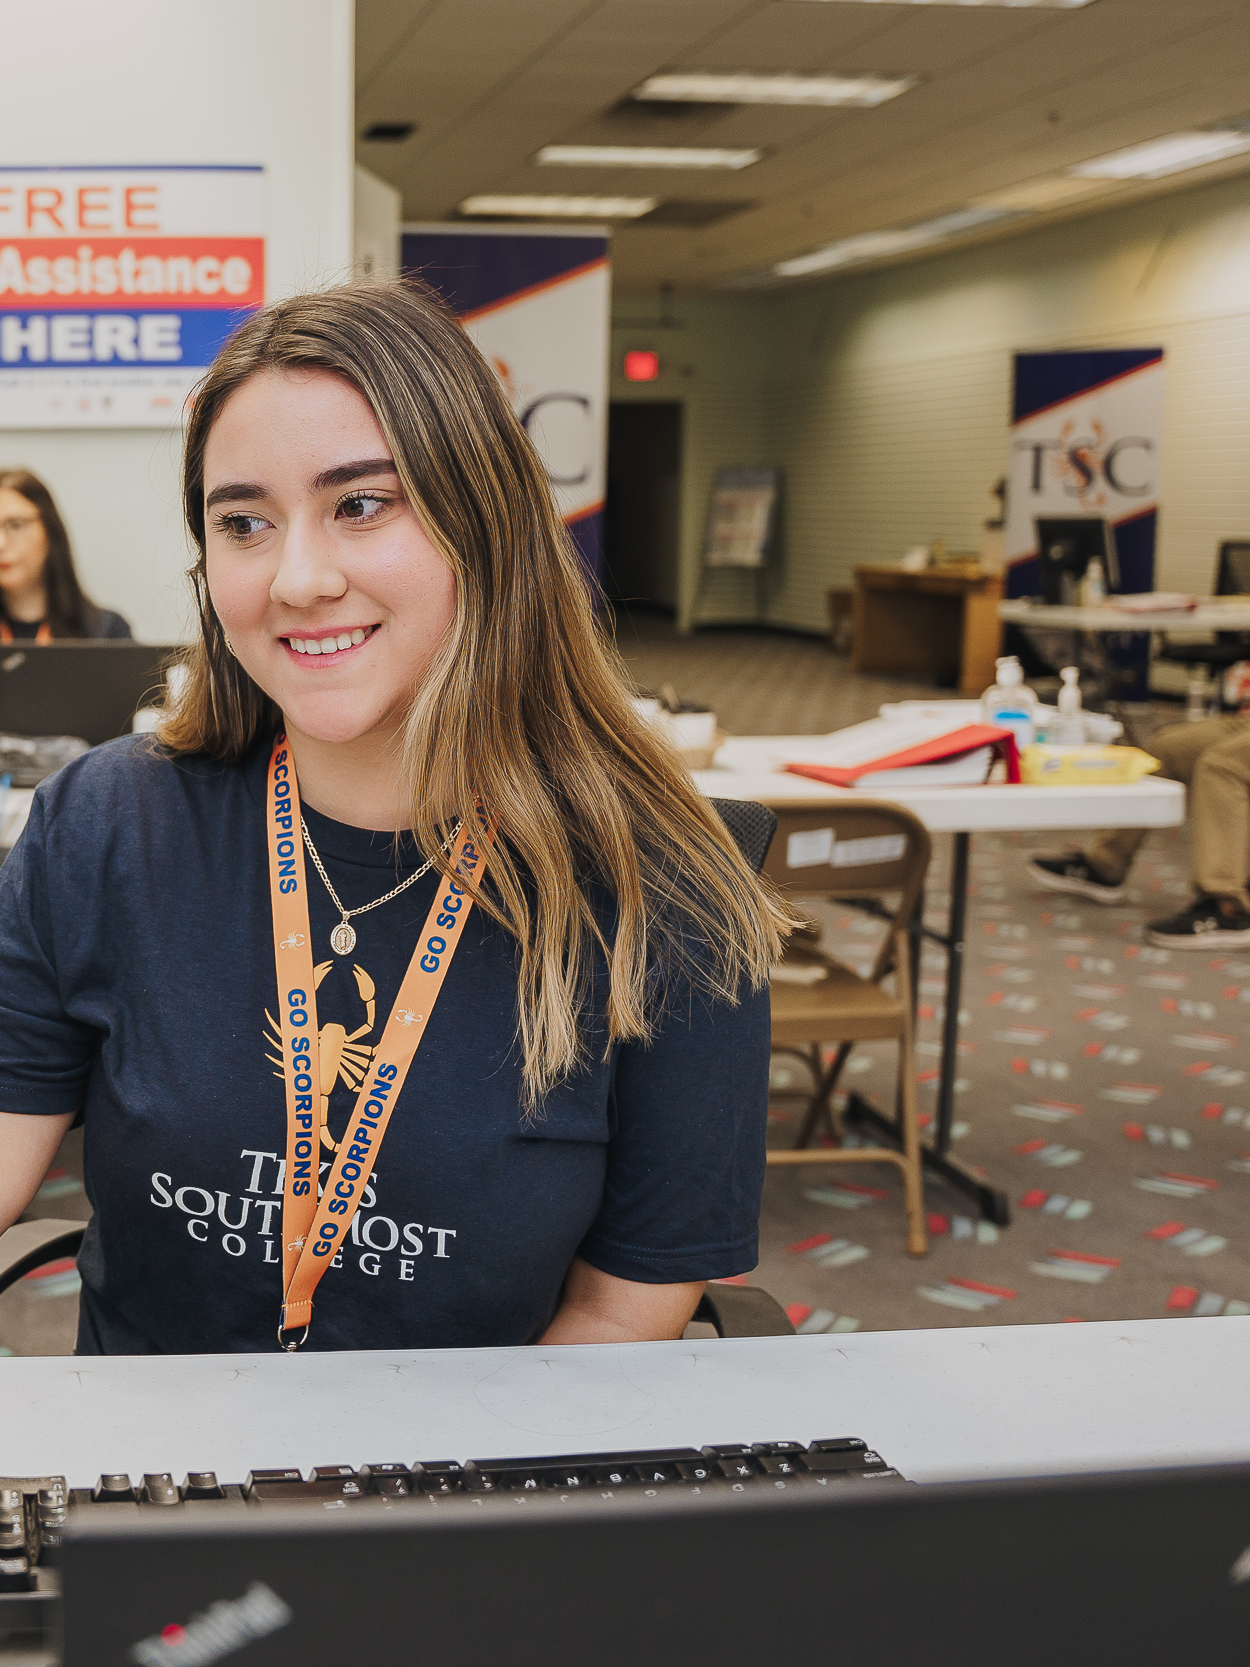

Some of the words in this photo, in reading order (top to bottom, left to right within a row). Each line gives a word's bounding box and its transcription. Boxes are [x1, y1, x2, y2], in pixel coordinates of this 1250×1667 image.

[0, 315, 182, 363] HERE
[1012, 436, 1157, 498] TSC
[275, 750, 298, 894] SCORPIONS
[421, 937, 447, 973] GO
[288, 988, 308, 1027] GO
[292, 1037, 313, 1197] SCORPIONS
[312, 1223, 339, 1257] GO
[328, 1062, 398, 1215] SCORPIONS
[150, 1172, 457, 1258] SOUTOST
[187, 1219, 415, 1282] COLEGE
